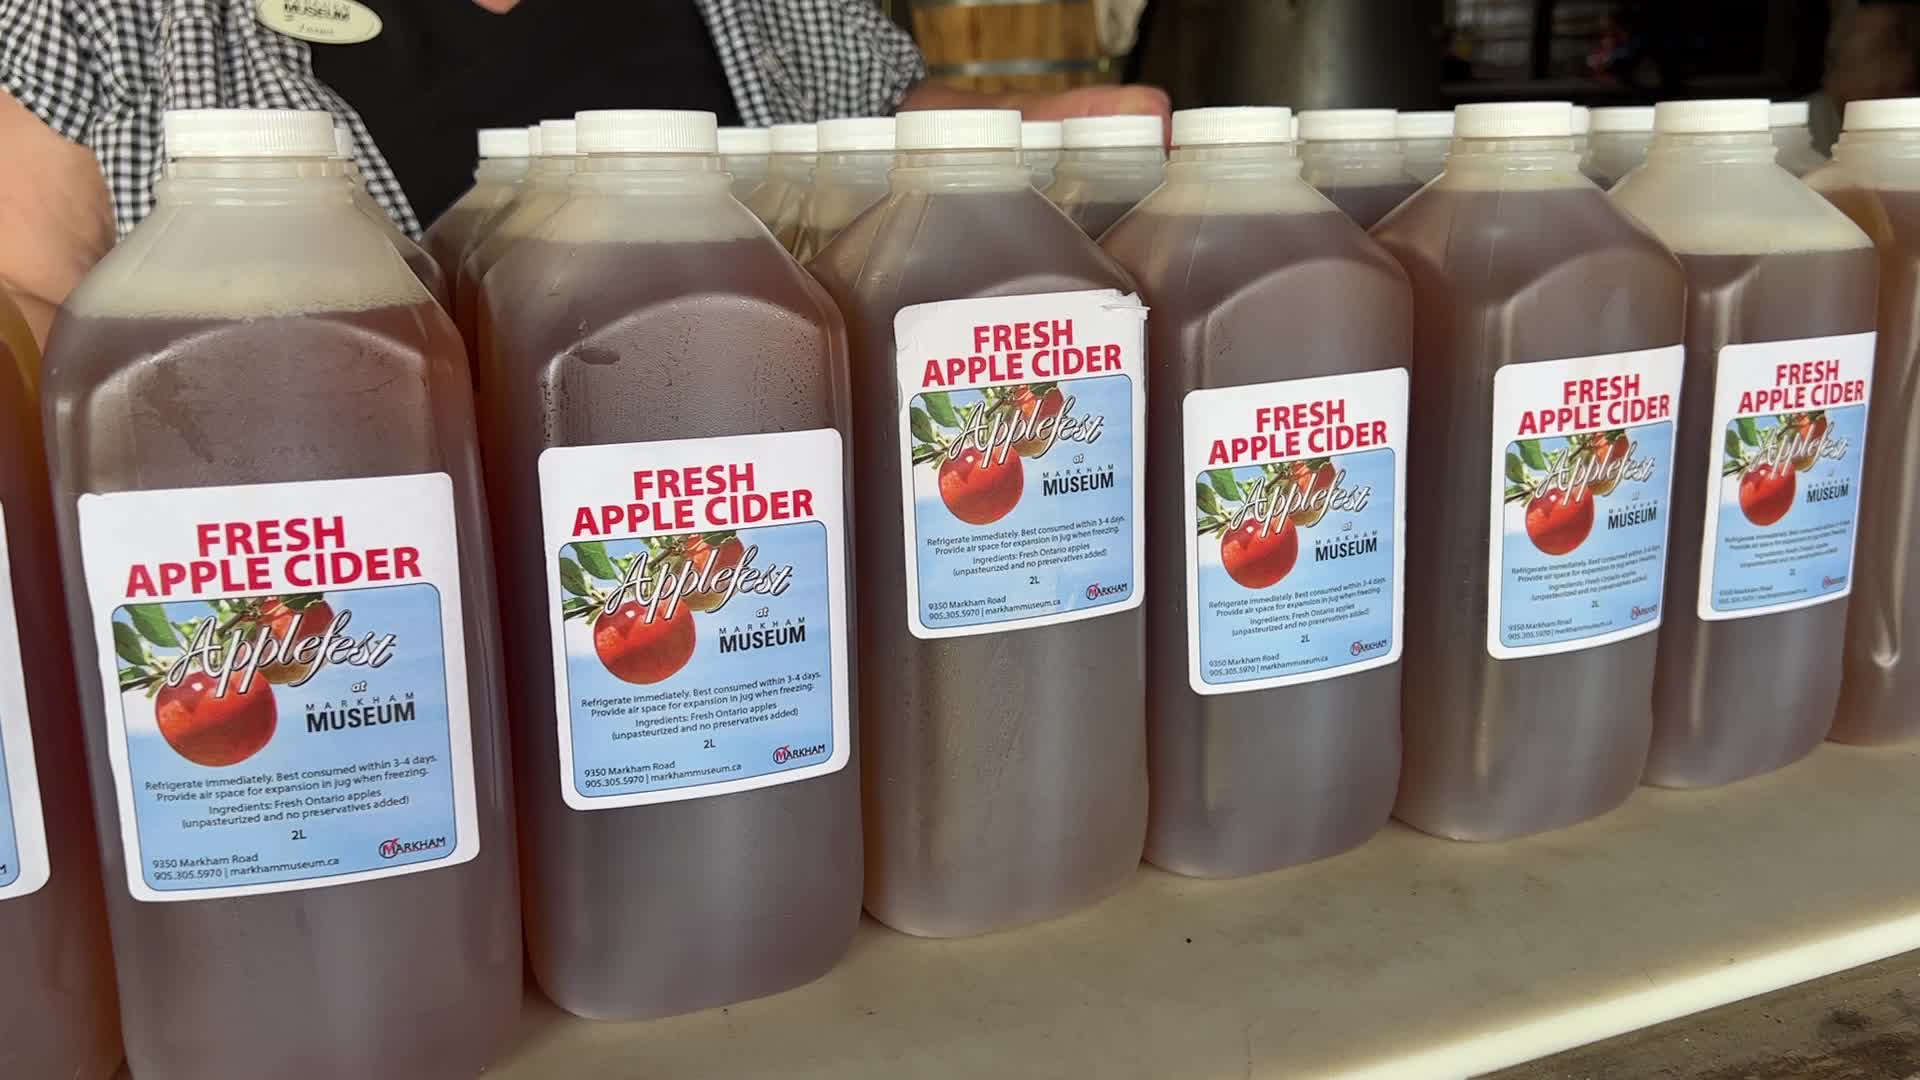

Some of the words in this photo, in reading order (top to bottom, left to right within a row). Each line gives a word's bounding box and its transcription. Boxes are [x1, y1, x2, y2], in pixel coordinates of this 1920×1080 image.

[973, 319, 1072, 352] FRESH
[922, 353, 1022, 387] APPLE
[1032, 344, 1121, 376] CIDER
[1774, 359, 1839, 386] FRESH
[1563, 373, 1640, 404] FRESH
[1738, 386, 1805, 413] APPLE
[1810, 379, 1863, 405] CIDER
[1256, 398, 1345, 432] FRESH
[1518, 404, 1600, 434] APPLE
[1607, 393, 1669, 424] CIDER
[948, 396, 1103, 468] Applefest
[1208, 431, 1299, 464] APPLE
[1308, 419, 1386, 452] CIDER
[634, 463, 753, 499] FRESH
[1043, 472, 1113, 495] MUSEUM
[1535, 441, 1655, 506] Applefest
[1231, 469, 1370, 537] Applefest
[1806, 483, 1849, 504] MUSEUM
[573, 499, 693, 536] APPLE
[705, 489, 812, 525] CIDER
[1607, 506, 1657, 529] MUSEUM
[195, 515, 343, 556] FRESH
[1315, 537, 1377, 561] MUSEUM
[126, 557, 270, 597] APPLE
[285, 546, 419, 586] CIDER
[605, 545, 792, 624] Applefest
[719, 617, 805, 633] MARKHAM
[756, 606, 769, 617] at
[720, 625, 805, 652] MUSEUM
[168, 610, 395, 698] Applefest
[351, 680, 368, 692] at
[581, 697, 631, 707] Refrigerate
[693, 687, 711, 696] Best
[713, 680, 757, 694] consumed
[759, 677, 785, 687] within
[787, 674, 800, 683] 3-4
[306, 692, 413, 710] MARKHAM
[591, 707, 625, 716] Provide
[641, 704, 666, 713] space
[668, 701, 681, 709] for
[683, 697, 727, 708] expansion
[739, 693, 753, 702] jug
[754, 689, 778, 698] when
[690, 711, 714, 720] Fresh
[715, 707, 748, 717] Ontario
[750, 702, 776, 713] apples
[307, 701, 415, 732] MUSEUM
[680, 723, 697, 732] and
[713, 714, 768, 729] preservatives
[703, 739, 715, 749] 2L
[772, 744, 825, 763] MARKHAM
[145, 780, 202, 791] Refrigerate
[276, 771, 299, 781] Best
[301, 763, 356, 778] consumed
[358, 761, 391, 771] within
[394, 757, 410, 767] 3-4
[584, 768, 606, 777] 9350
[608, 765, 650, 774] Markham
[652, 760, 675, 770] Road
[585, 775, 644, 788] 905.305.5970
[651, 764, 741, 781] markhammuseum.ca
[156, 792, 196, 802] Provide
[200, 791, 212, 799] air
[215, 789, 244, 799] space
[247, 787, 262, 795] for
[265, 782, 319, 794] expansion
[334, 778, 351, 789] jug
[352, 774, 382, 783] when
[274, 798, 303, 808] Fresh
[305, 794, 344, 805] Ontario
[347, 789, 381, 801] apples
[263, 811, 283, 821] and
[302, 802, 370, 819] preservatives
[291, 829, 308, 840] 2L
[378, 837, 446, 858] MARKHAM
[153, 859, 177, 868] 9350
[179, 857, 229, 867] Markham
[231, 852, 259, 863] Road
[154, 868, 221, 880] 905.305.5970
[230, 858, 339, 875] markhammuseum.ca
